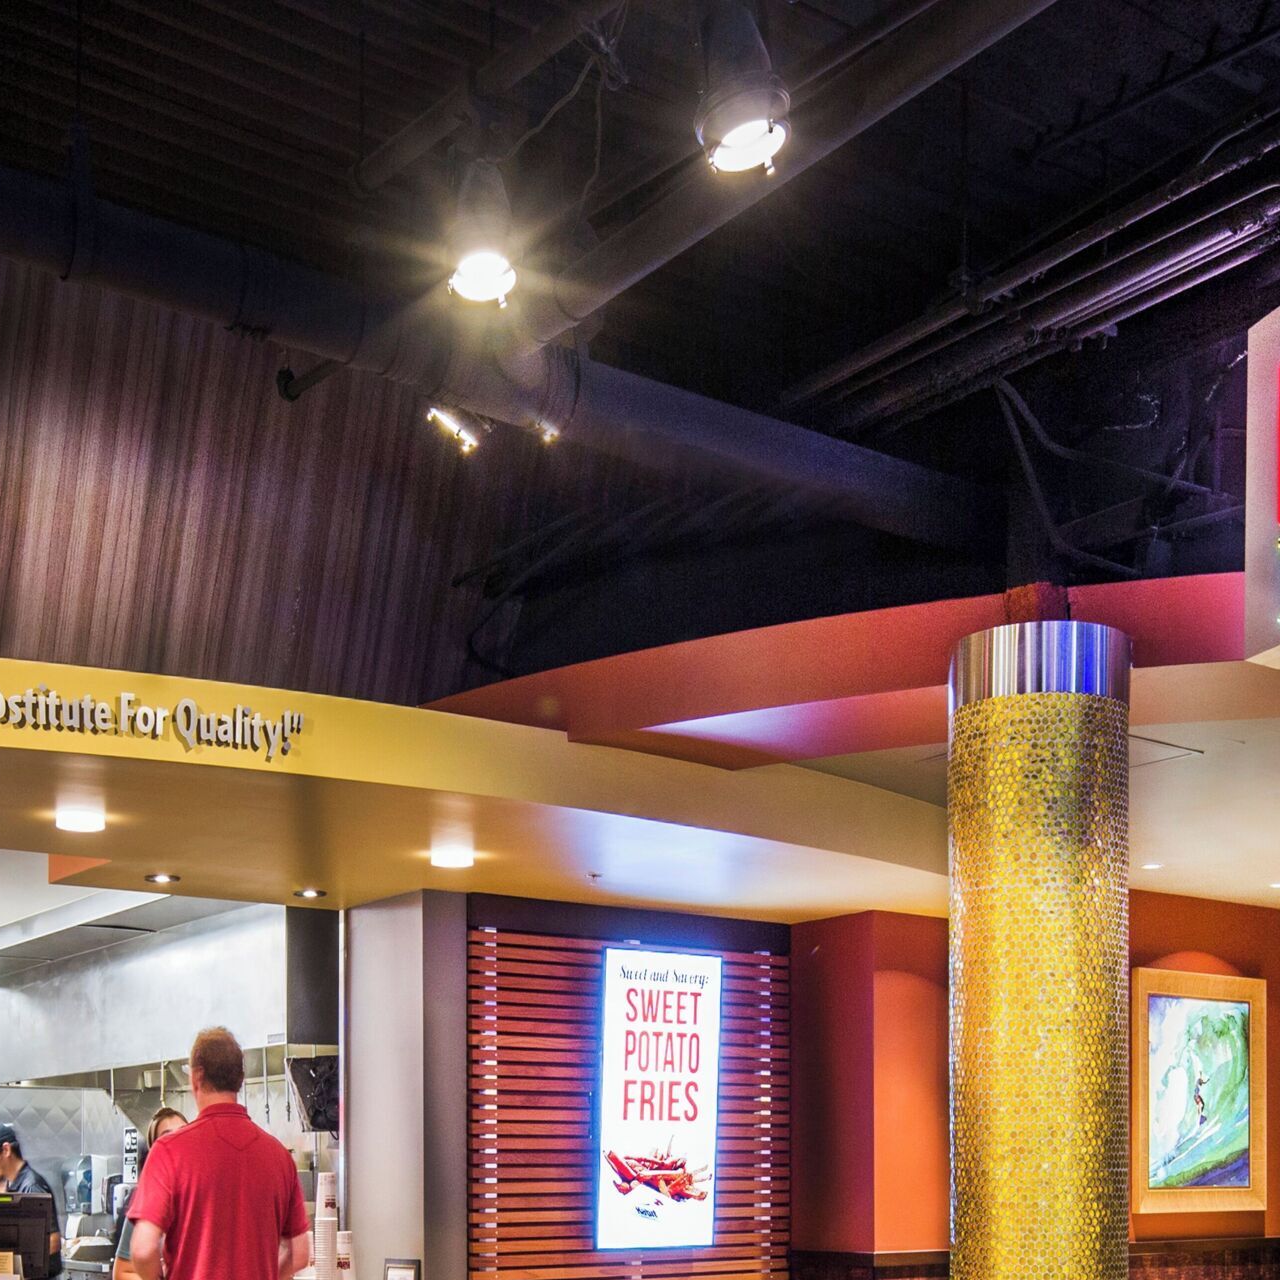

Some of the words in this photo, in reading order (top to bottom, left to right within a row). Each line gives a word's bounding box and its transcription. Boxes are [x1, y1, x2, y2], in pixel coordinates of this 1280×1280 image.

[120, 692, 169, 736] For
[176, 698, 305, 761] Quality!"
[619, 964, 646, 981] Sweet
[649, 966, 668, 983] and
[625, 987, 701, 1025] SWEET
[624, 1030, 700, 1074] POTATO
[622, 1079, 699, 1122] FRIES
